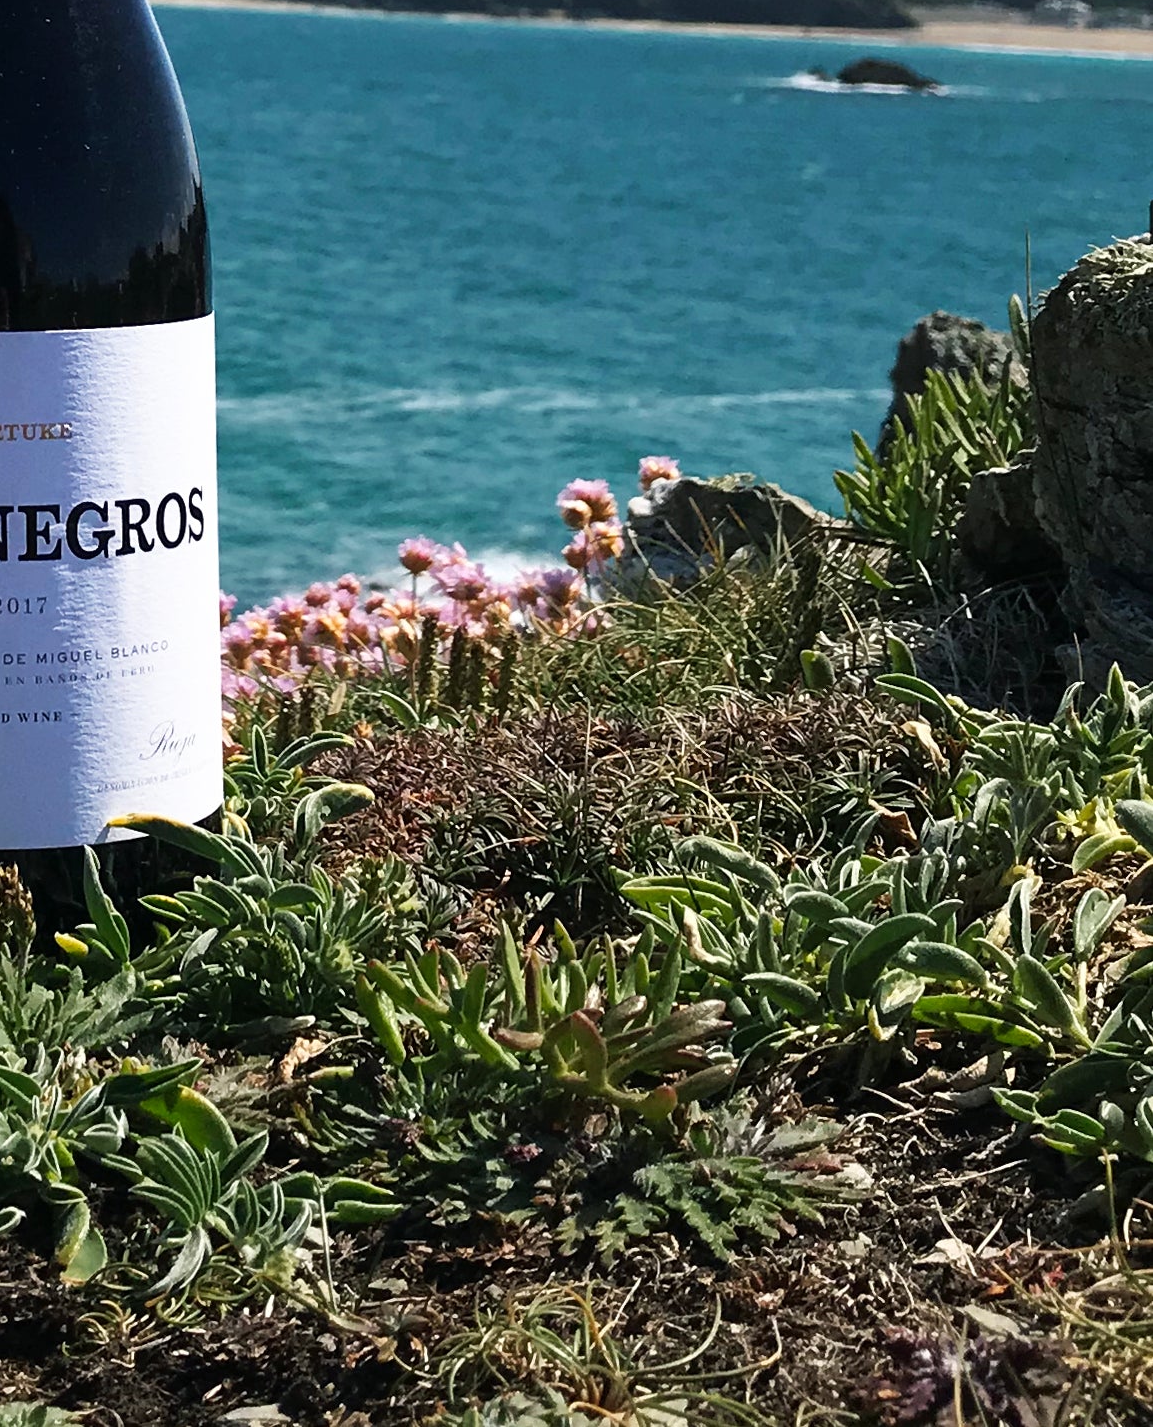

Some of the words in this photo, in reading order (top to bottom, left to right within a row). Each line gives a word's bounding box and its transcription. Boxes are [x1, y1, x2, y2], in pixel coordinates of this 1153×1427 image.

[3, 653, 26, 665] DE
[36, 649, 103, 665] MIGUEL
[111, 639, 169, 659] BLANCO
[5, 676, 25, 685] EN
[18, 710, 63, 723] WINE
